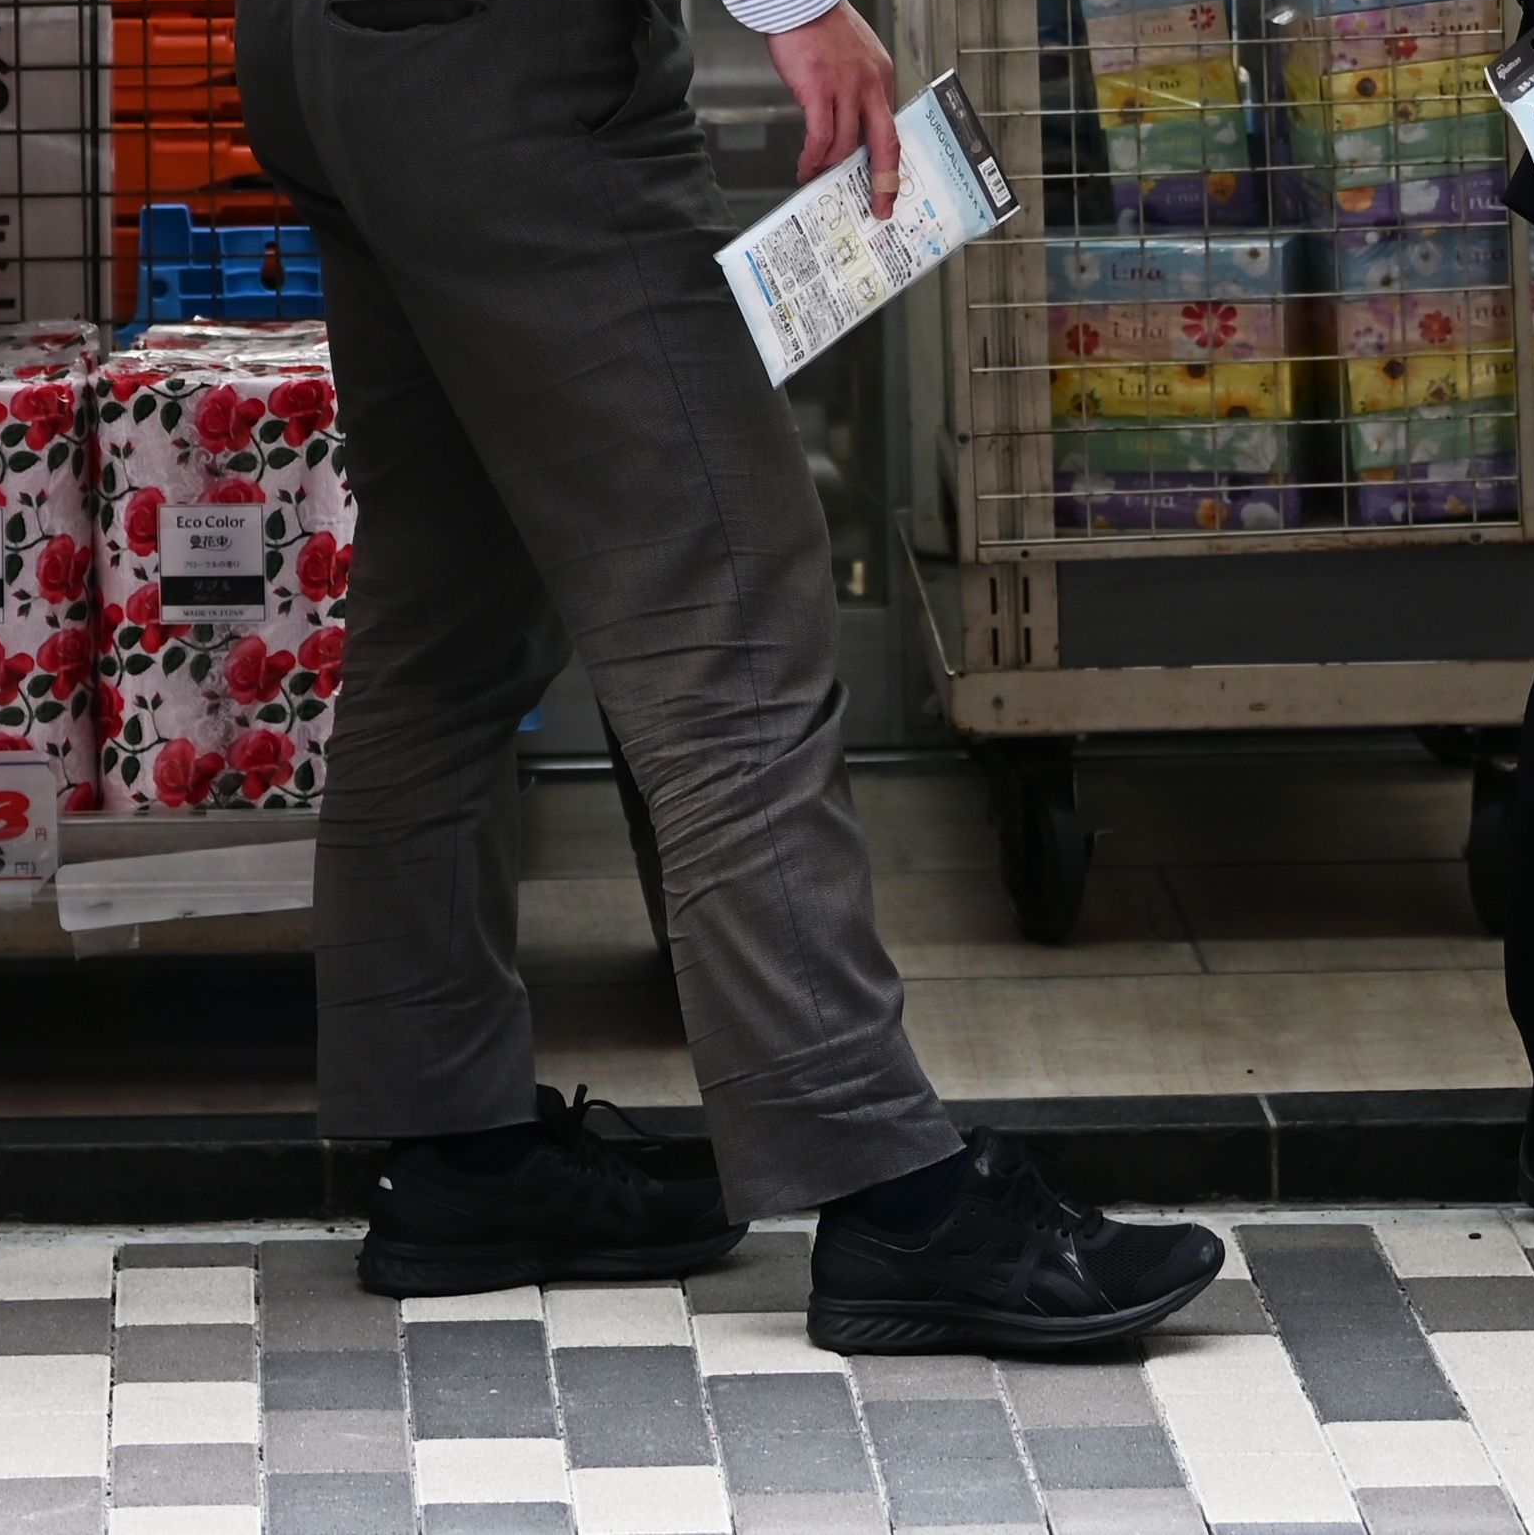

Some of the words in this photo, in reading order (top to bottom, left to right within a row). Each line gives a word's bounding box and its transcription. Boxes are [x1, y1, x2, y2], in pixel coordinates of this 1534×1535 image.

[177, 516, 202, 528] Eco
[205, 515, 245, 528] Color
[35, 827, 47, 841] 円
